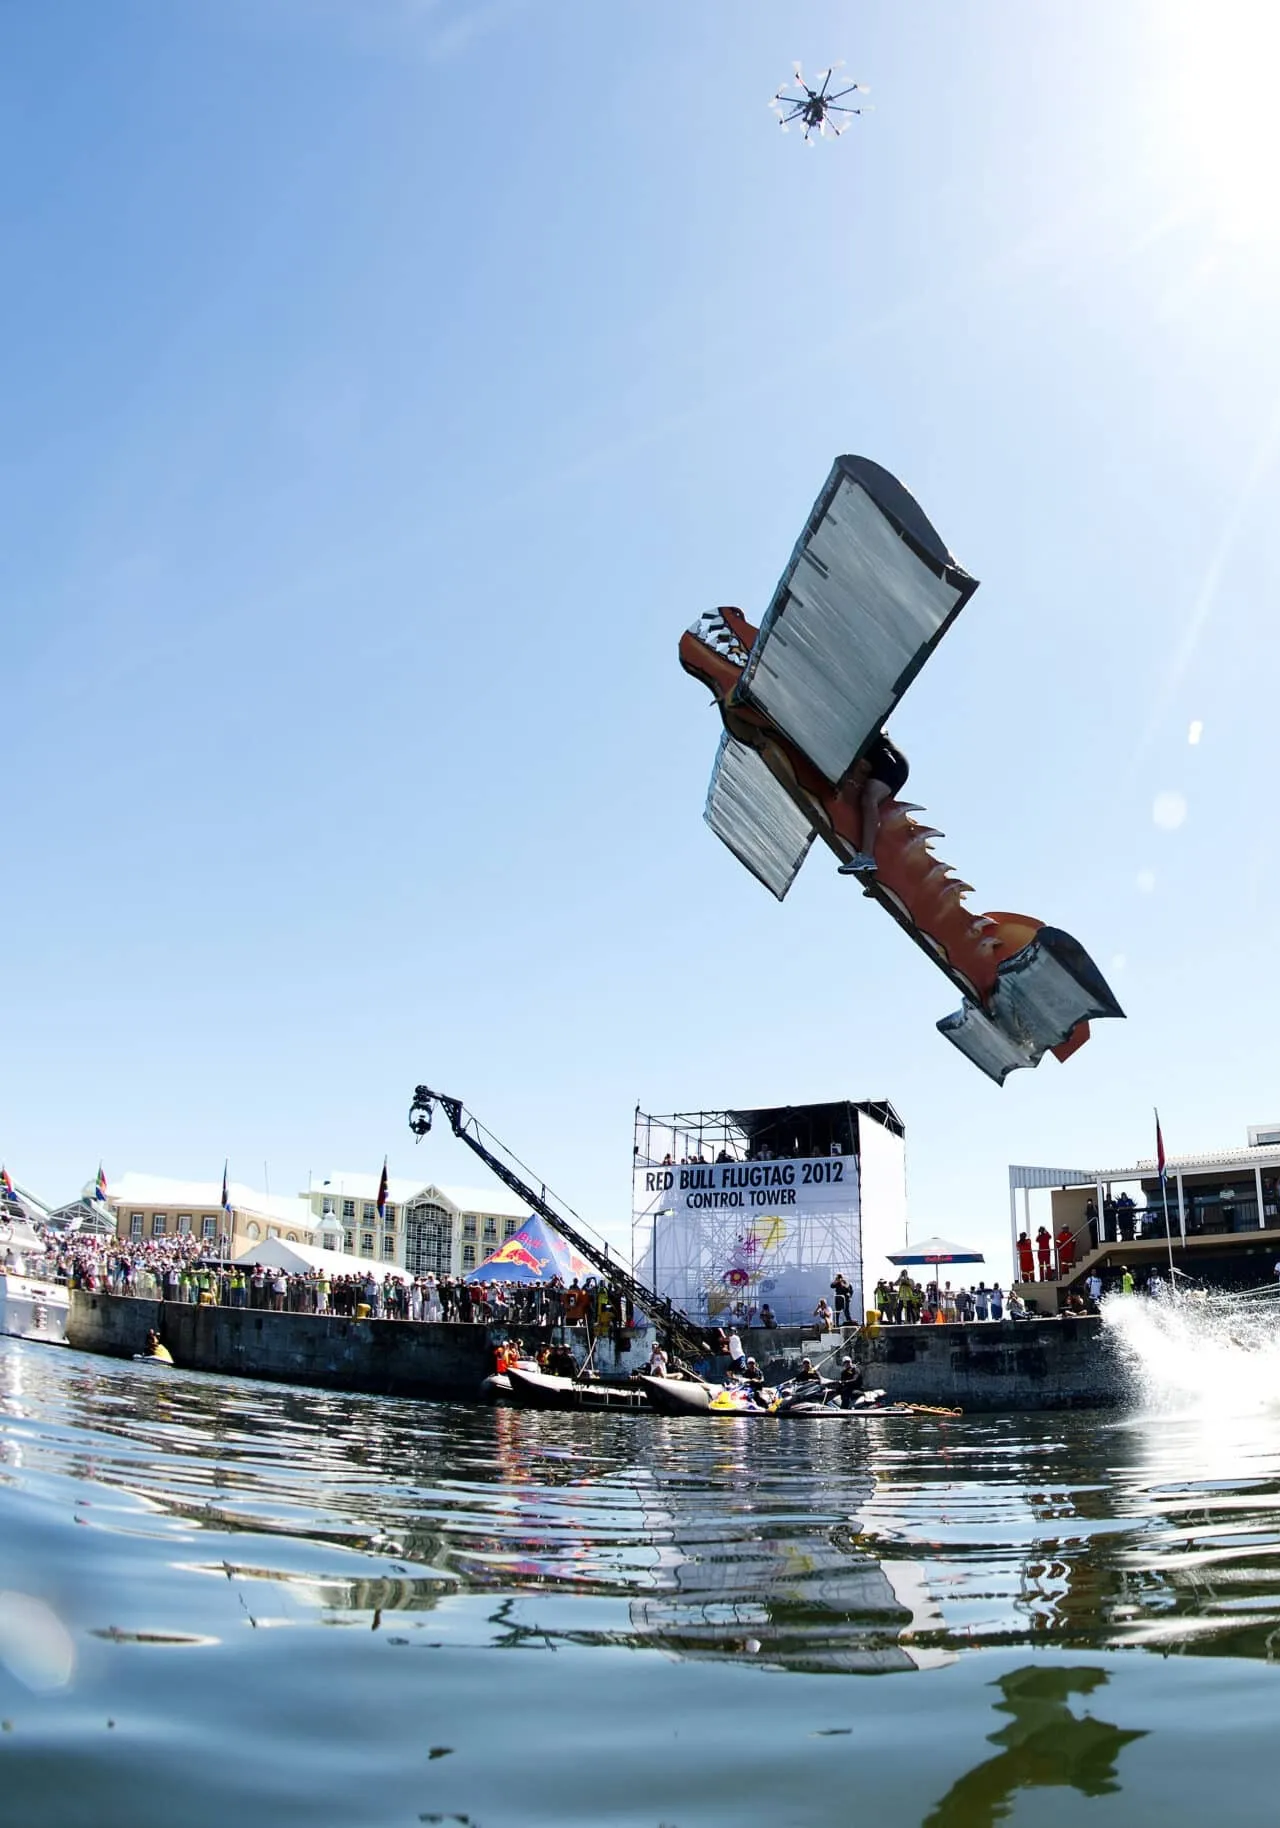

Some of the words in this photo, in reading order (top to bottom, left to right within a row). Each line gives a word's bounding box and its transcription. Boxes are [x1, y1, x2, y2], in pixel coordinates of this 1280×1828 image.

[645, 1171, 674, 1192] RED
[680, 1169, 716, 1190] BULL
[721, 1164, 796, 1188] FLUGTAG
[802, 1161, 843, 1184] 2012
[686, 1191, 745, 1209] CONTROL
[748, 1188, 796, 1206] TOWER
